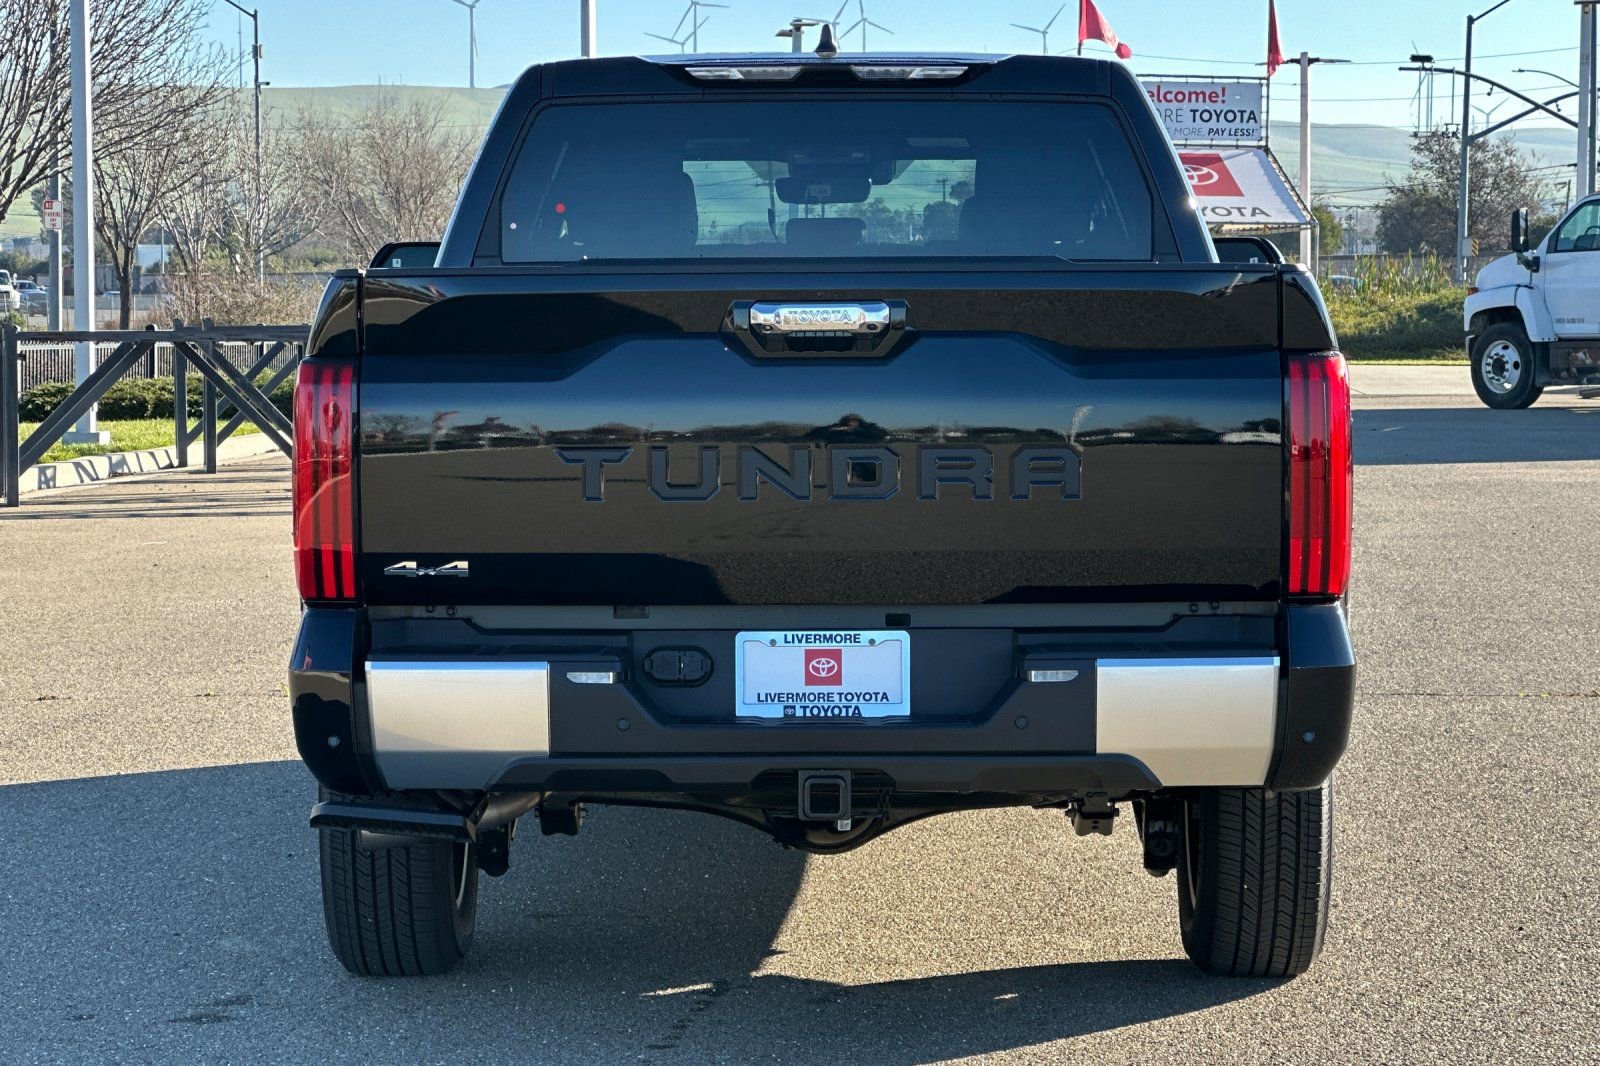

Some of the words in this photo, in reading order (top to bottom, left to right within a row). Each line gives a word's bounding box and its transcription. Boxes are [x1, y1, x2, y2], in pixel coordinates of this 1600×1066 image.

[1190, 109, 1258, 123] TOYOTA
[1208, 128, 1227, 136] PAY
[1228, 128, 1255, 137] LESS!
[788, 309, 852, 323] TOYOTA
[552, 445, 1084, 502] TUNDRA
[784, 633, 861, 644] LIVERMORE
[757, 692, 834, 703] LIVERMORE
[837, 692, 889, 702] TOYOTA
[800, 705, 862, 717] TOYOTA
